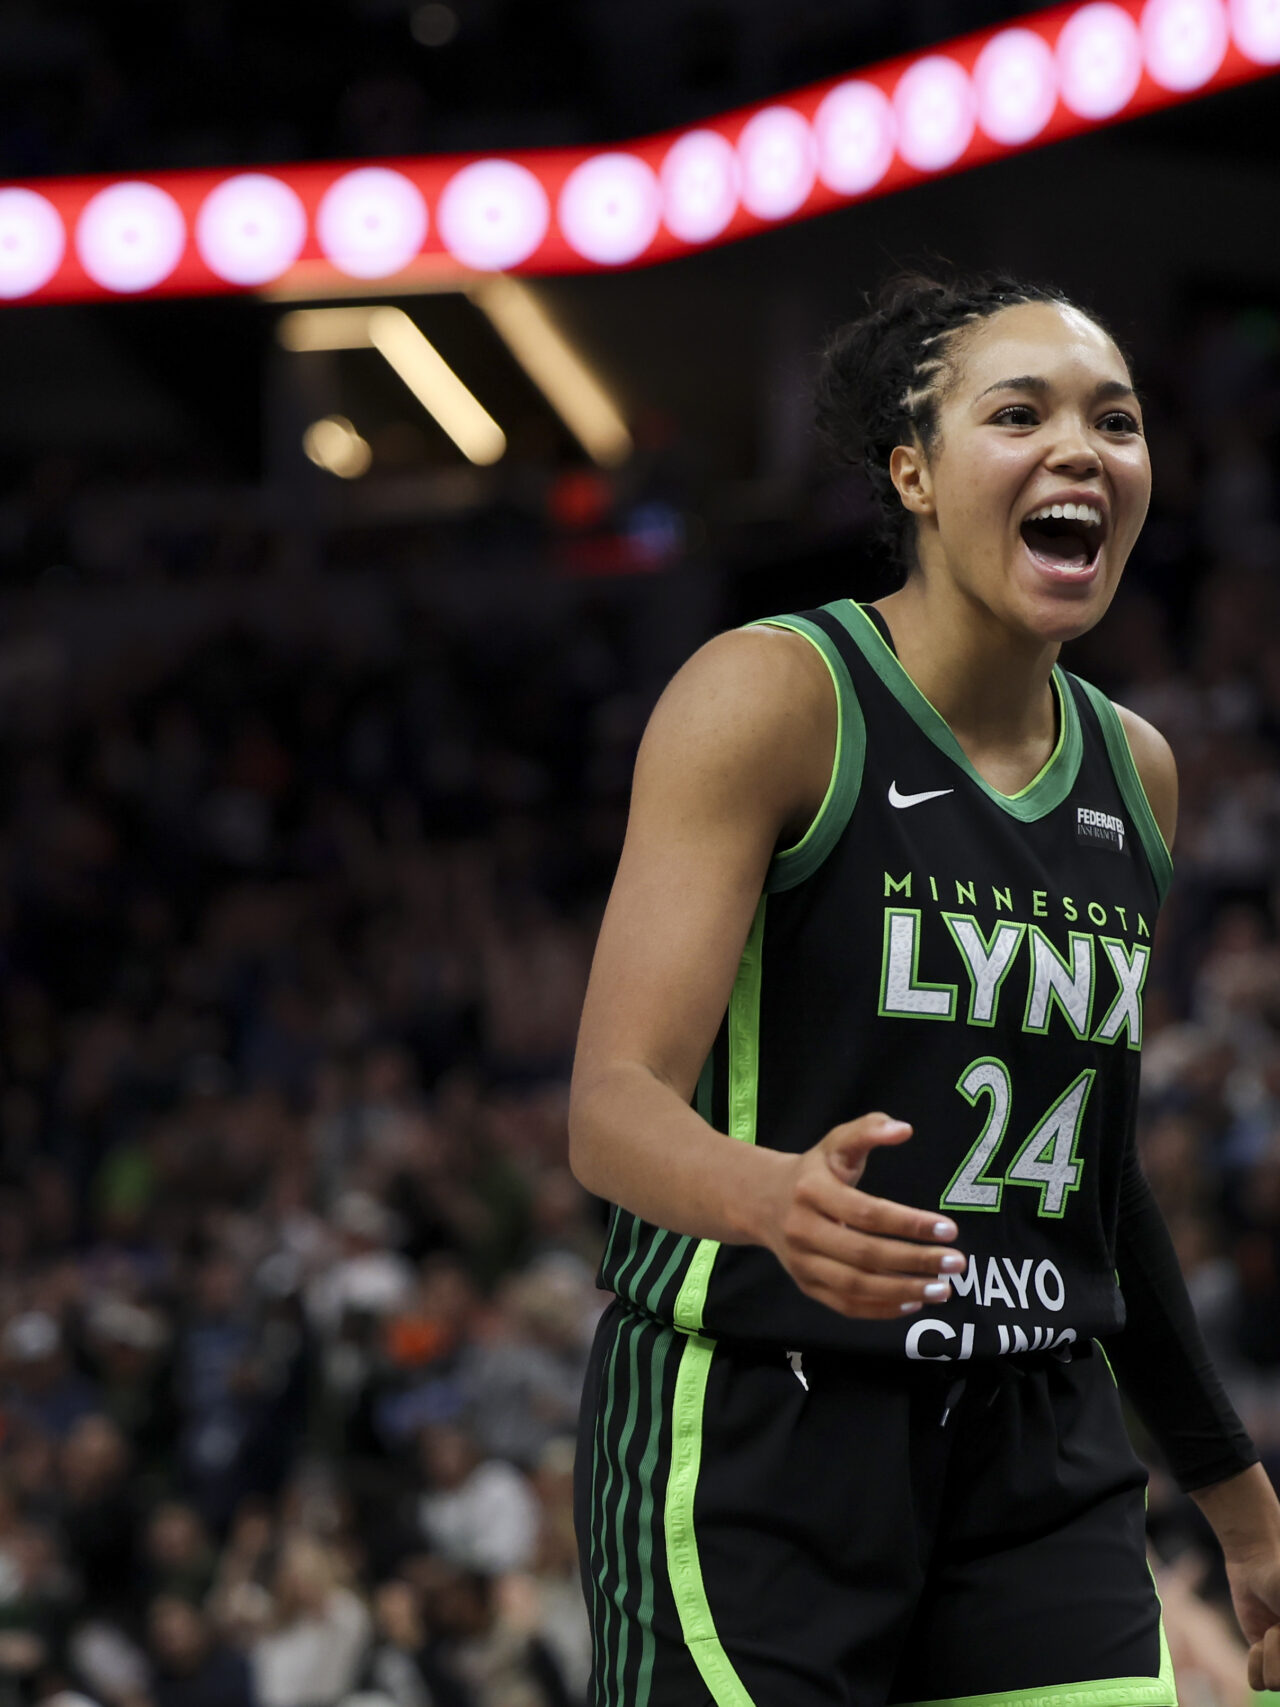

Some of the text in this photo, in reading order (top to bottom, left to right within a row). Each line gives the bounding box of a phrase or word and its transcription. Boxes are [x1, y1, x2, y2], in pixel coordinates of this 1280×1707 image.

[877, 907, 1152, 1052] LYNX
[939, 1055, 1097, 1218] 24
[937, 1254, 1066, 1312] MAYO
